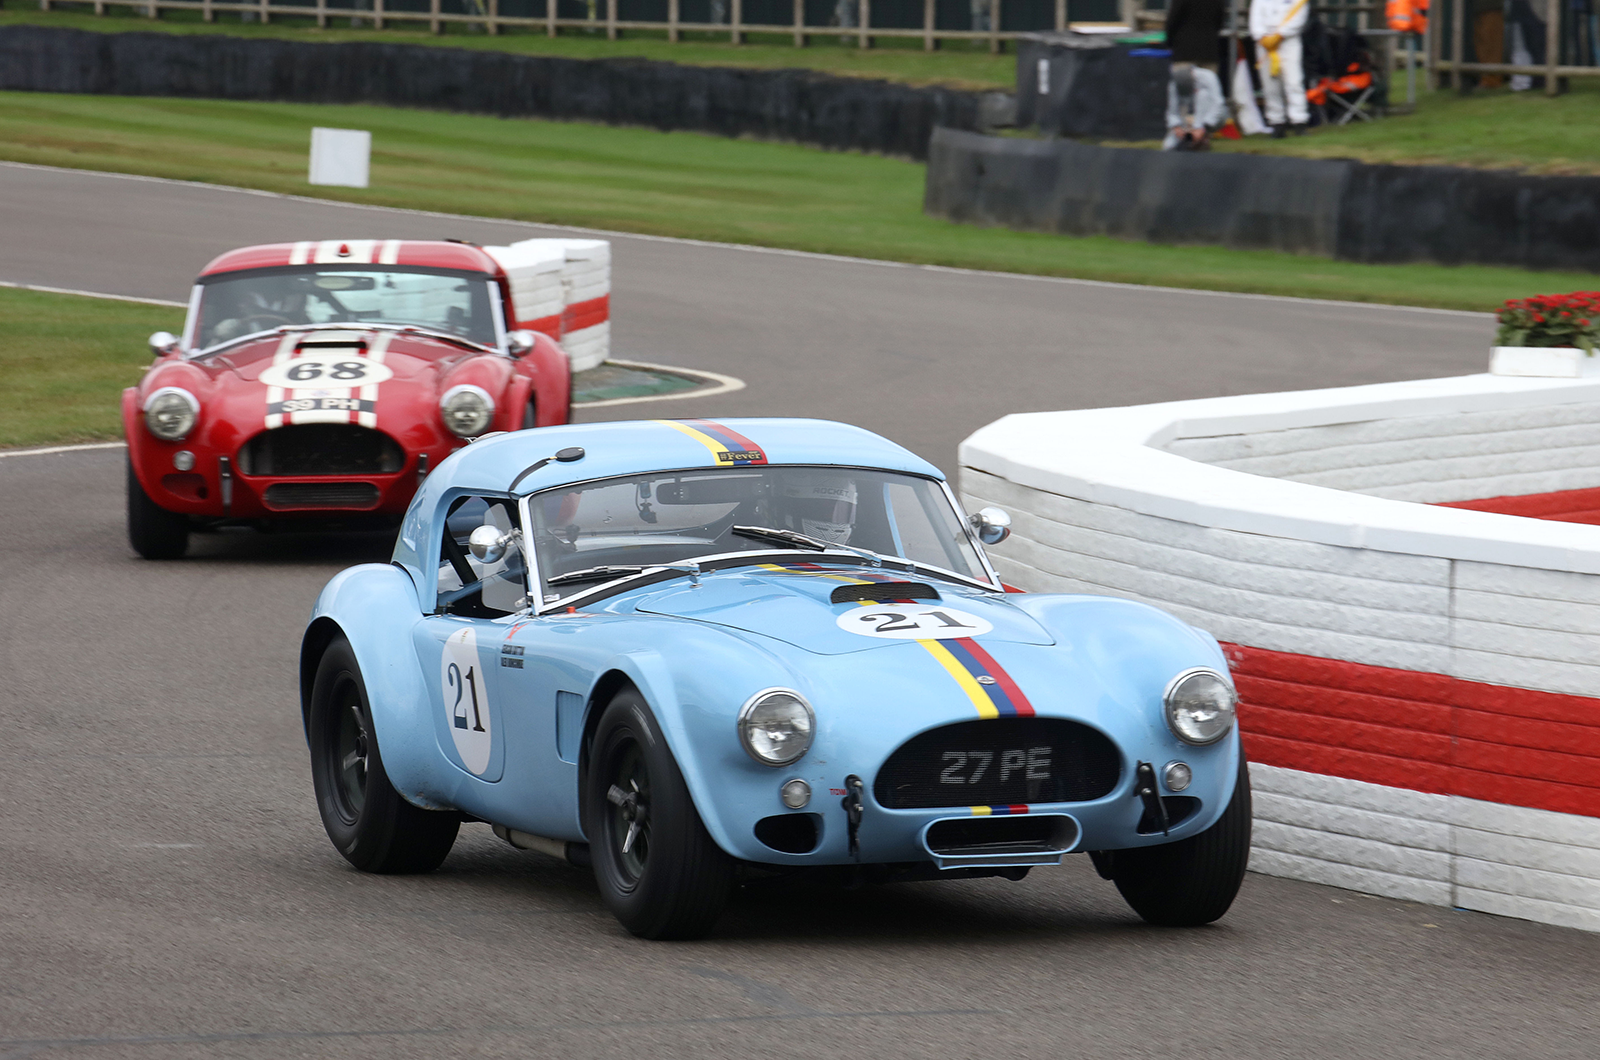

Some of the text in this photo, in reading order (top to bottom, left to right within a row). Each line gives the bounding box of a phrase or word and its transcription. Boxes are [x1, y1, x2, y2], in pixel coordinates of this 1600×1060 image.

[286, 361, 366, 381] 68
[320, 398, 360, 410] PH
[812, 487, 850, 497] ROCKET
[859, 611, 977, 632] 21
[447, 662, 486, 733] 21
[940, 747, 1052, 784] 27 PE
